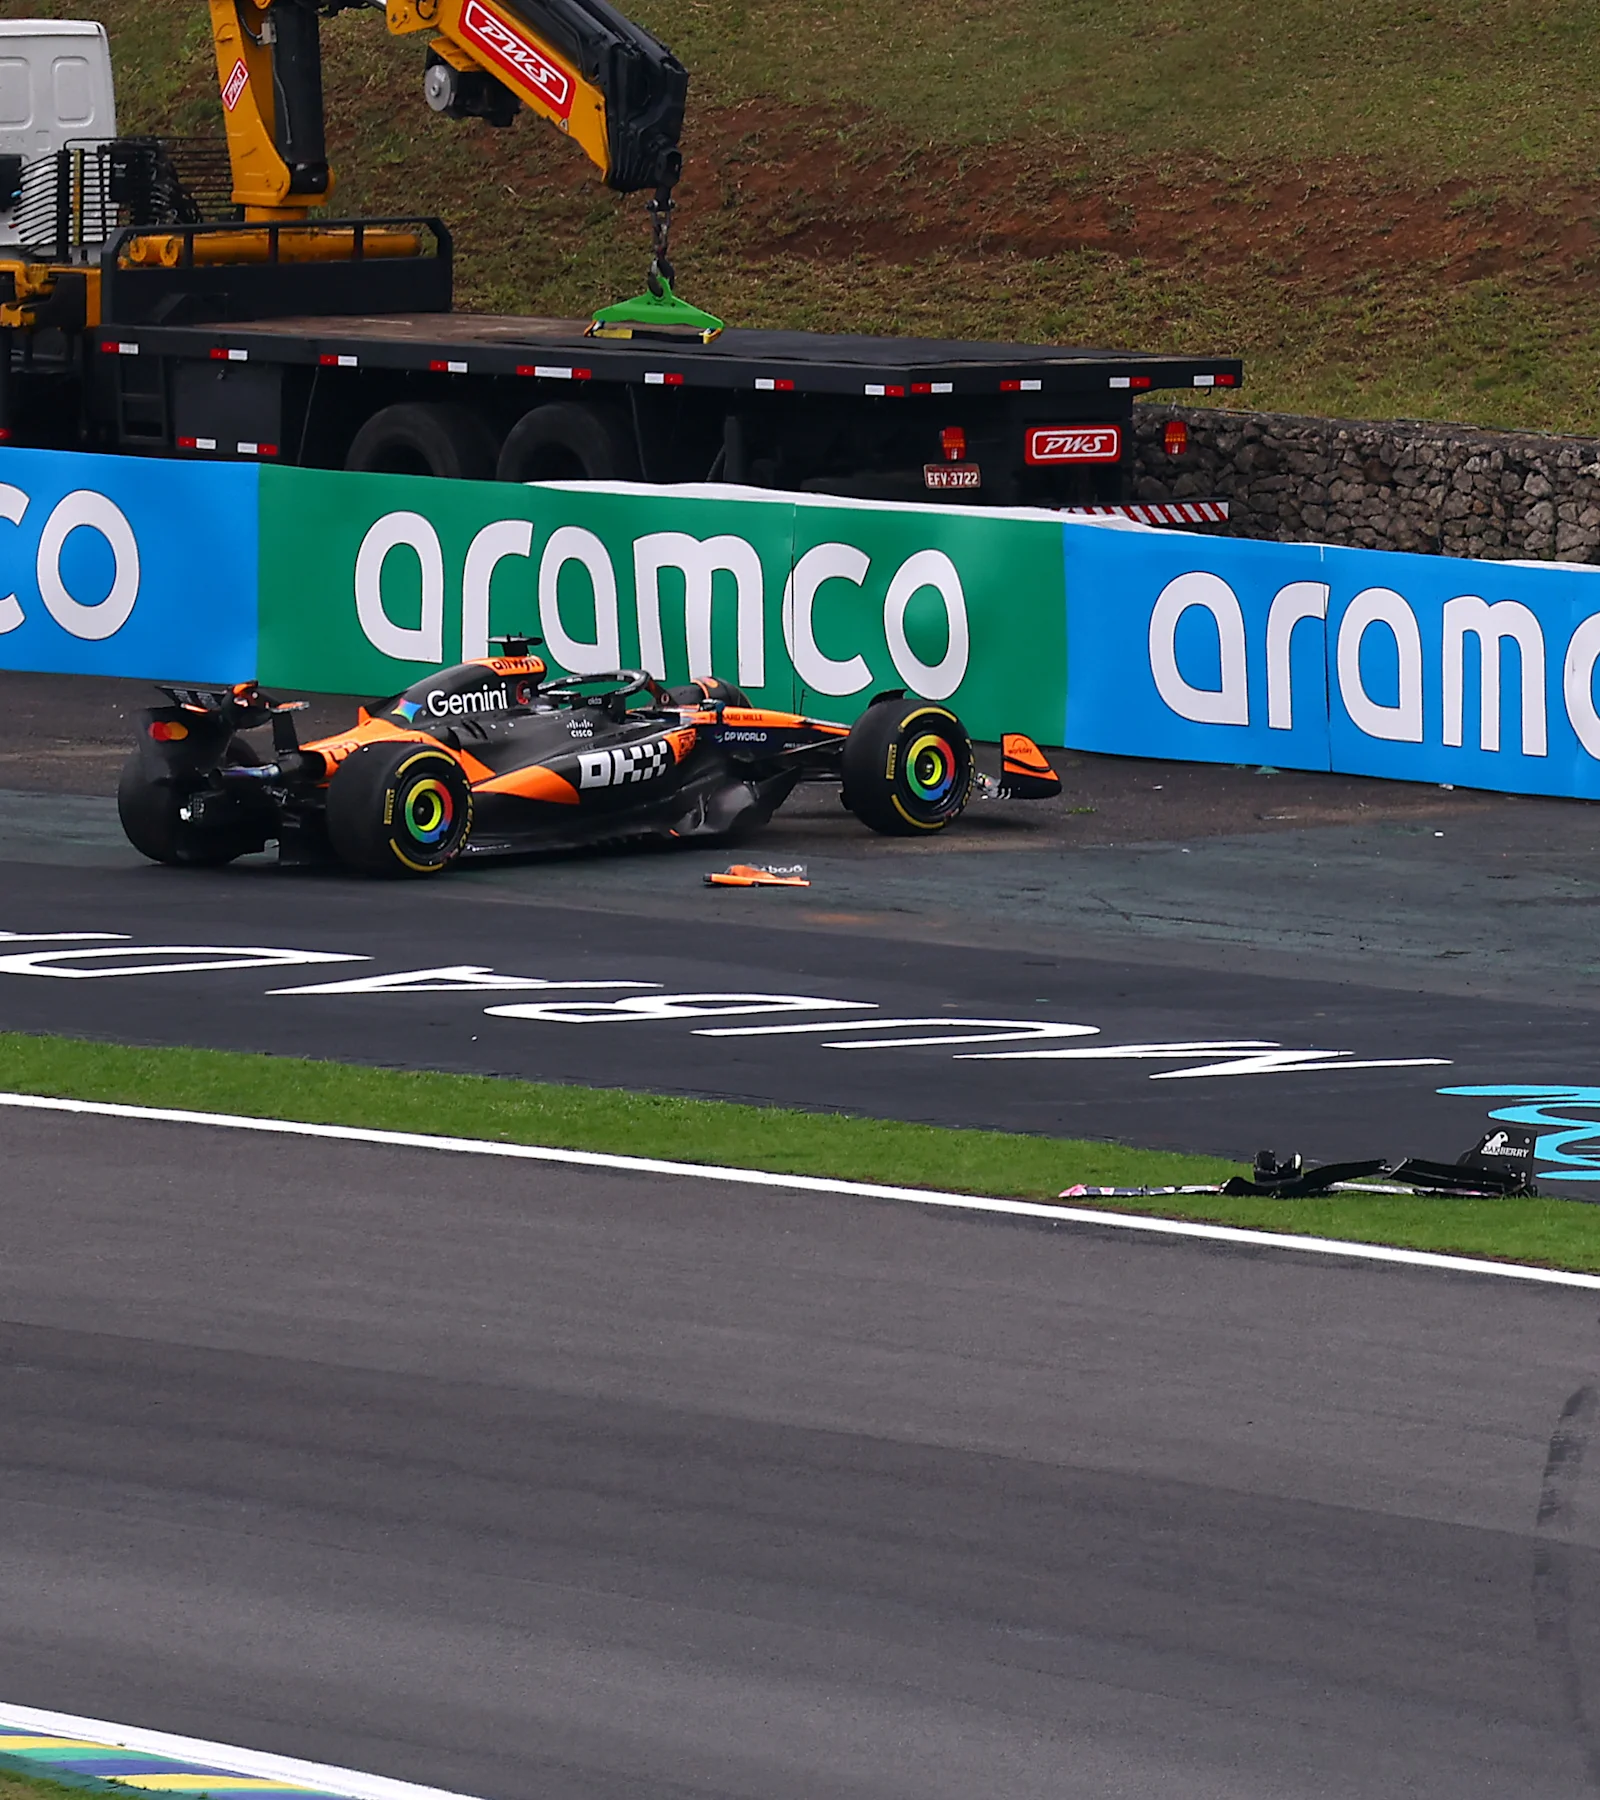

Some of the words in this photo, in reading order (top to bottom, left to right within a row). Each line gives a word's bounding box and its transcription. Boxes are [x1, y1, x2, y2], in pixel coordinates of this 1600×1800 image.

[478, 19, 558, 86] PWS
[1044, 434, 1109, 454] PWS
[354, 511, 970, 701] aramco
[426, 682, 508, 717] Gemini
[736, 732, 767, 742] WORLD
[577, 741, 668, 789] OKX
[0, 929, 1454, 1080] MUBAD
